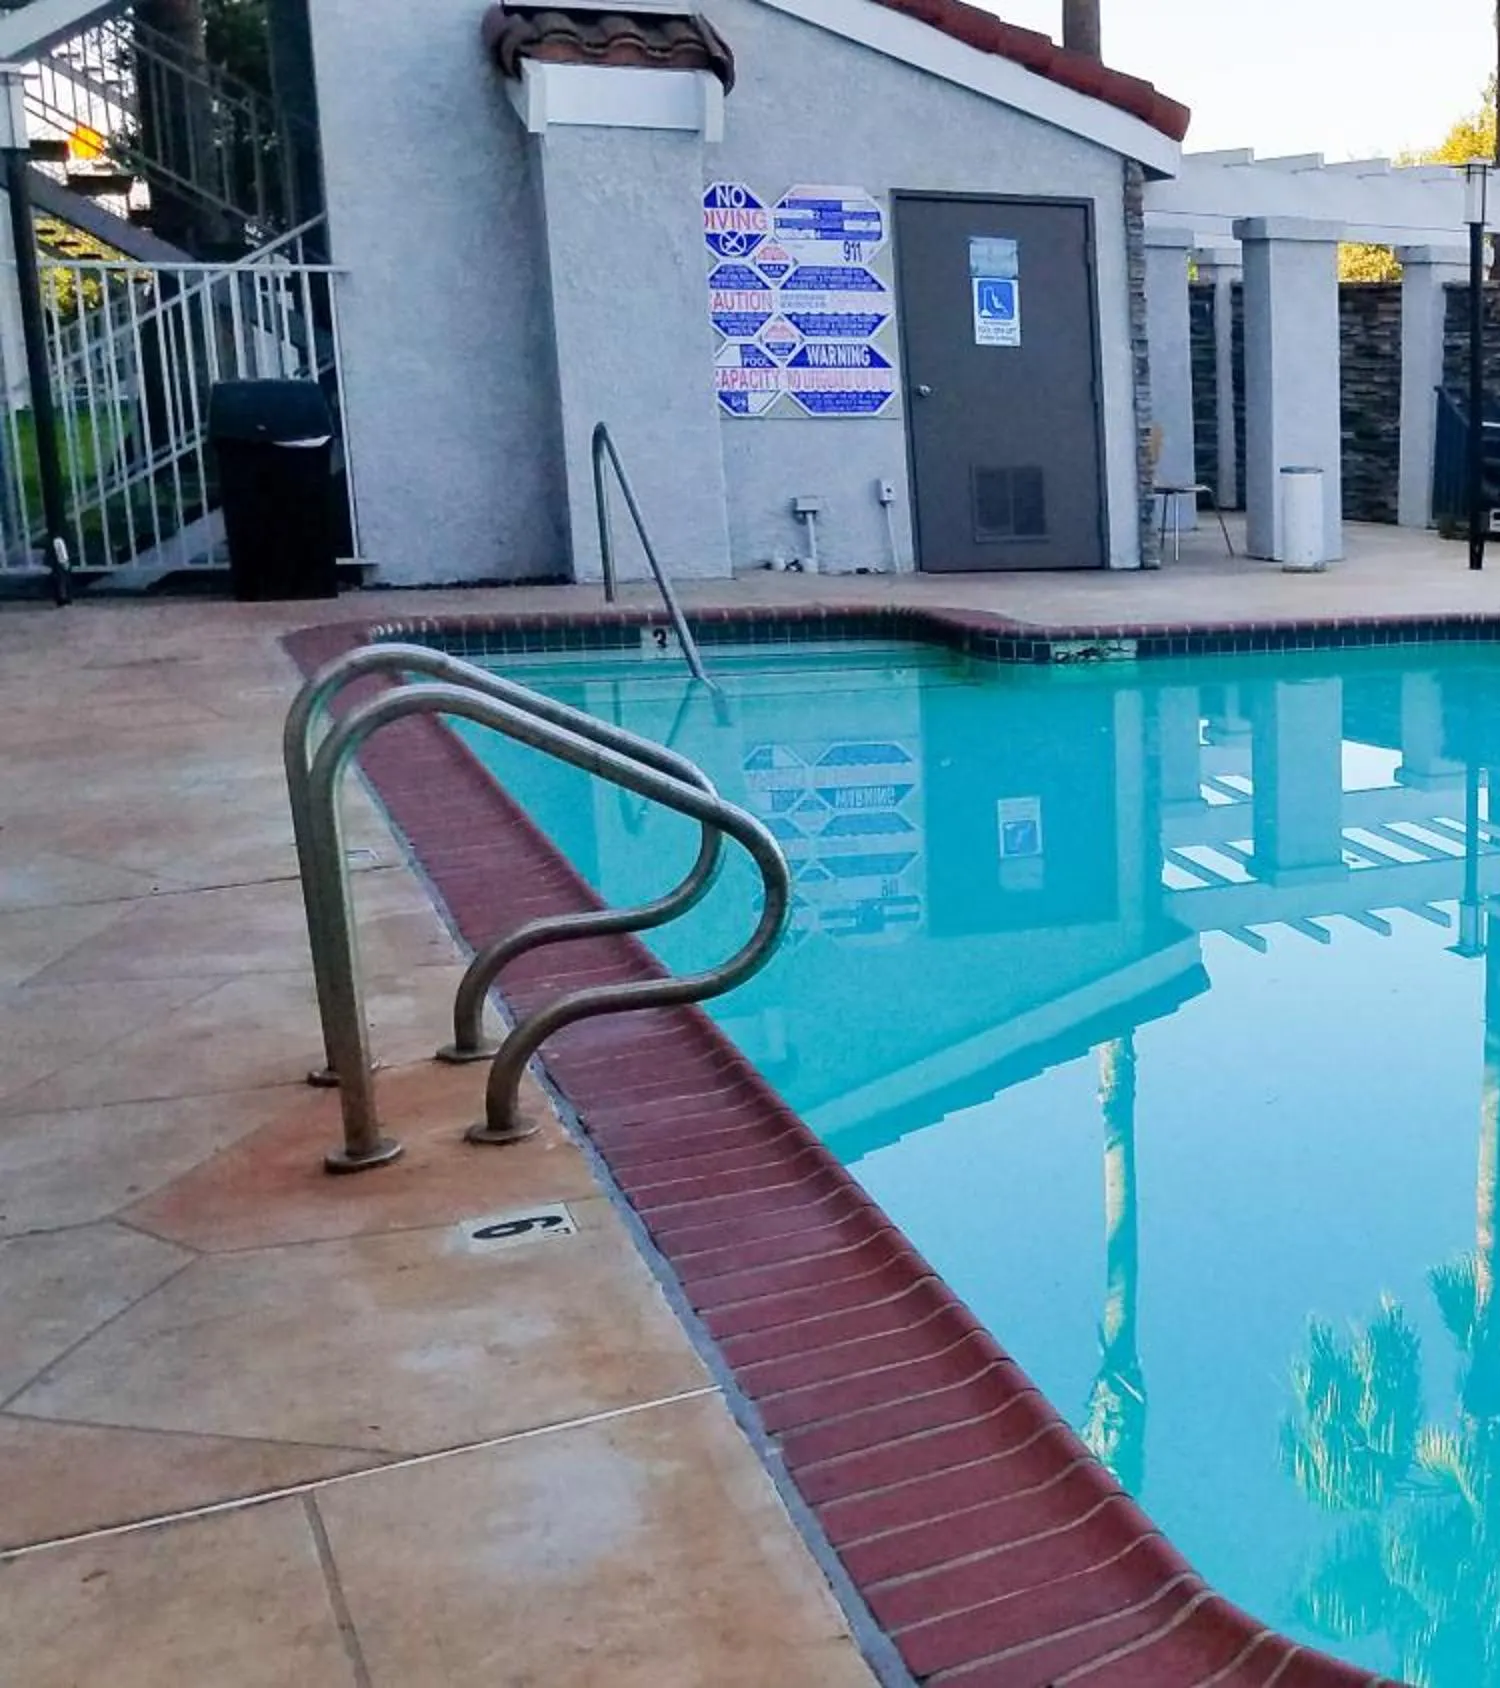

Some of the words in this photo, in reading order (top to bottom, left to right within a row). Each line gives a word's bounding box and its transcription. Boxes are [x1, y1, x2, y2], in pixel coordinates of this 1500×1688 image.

[715, 185, 747, 208] NO
[843, 240, 863, 262] 911
[712, 291, 773, 310] AUTION
[805, 344, 871, 366] WARNING
